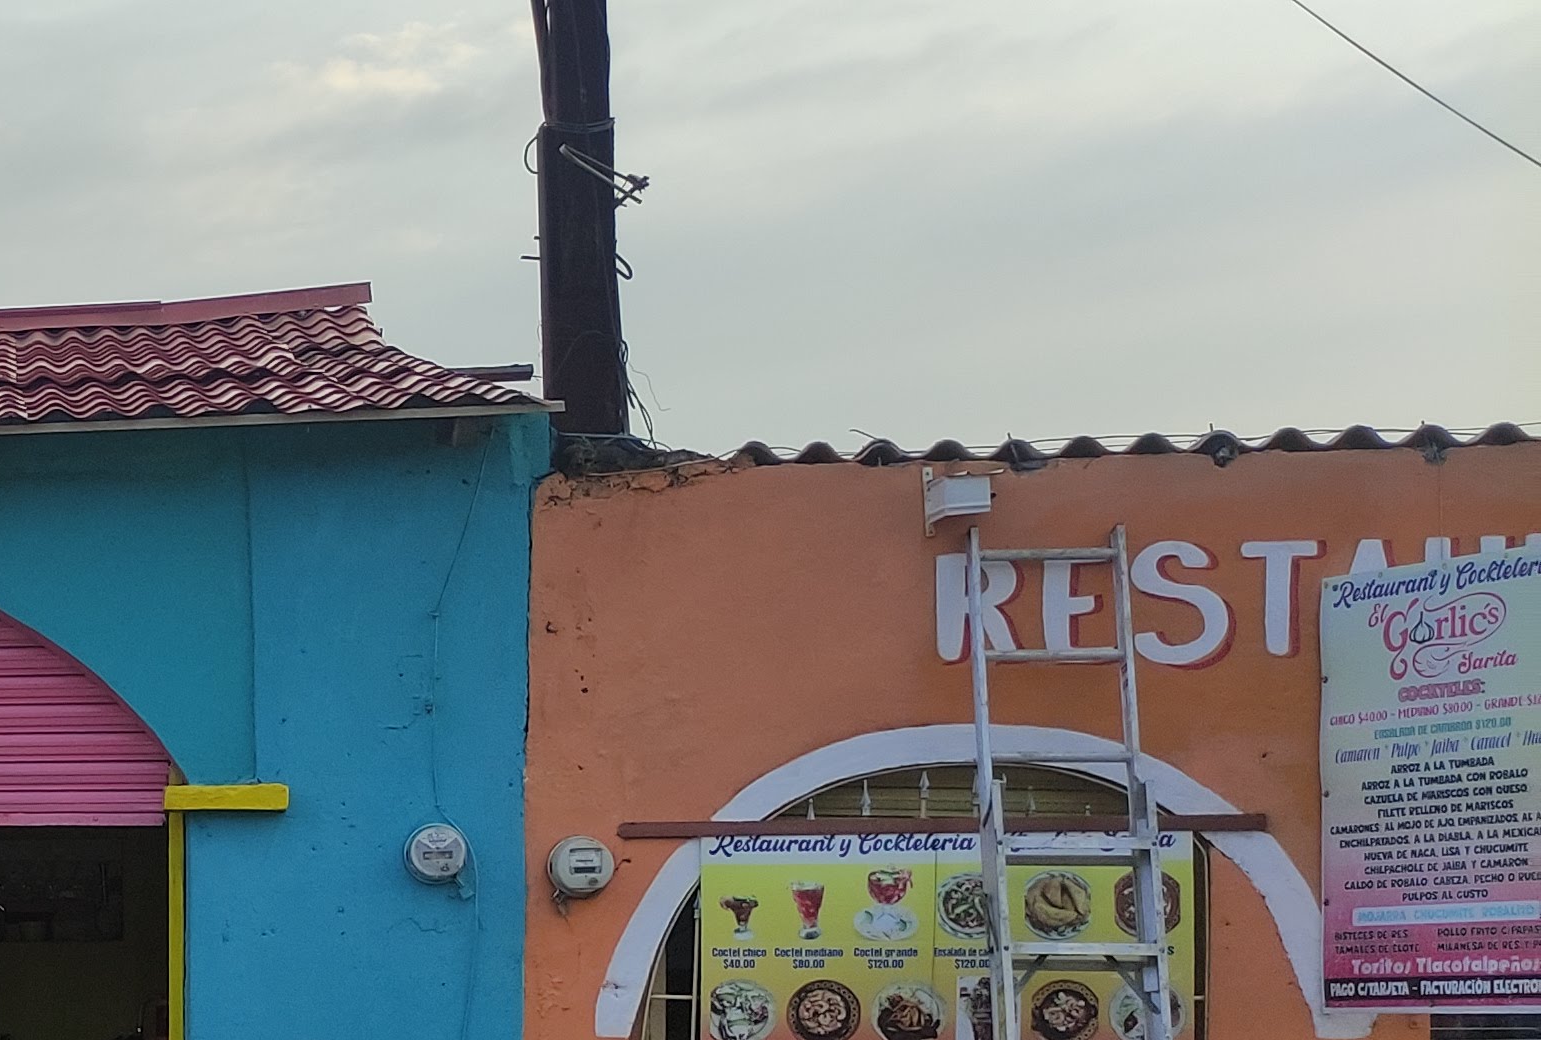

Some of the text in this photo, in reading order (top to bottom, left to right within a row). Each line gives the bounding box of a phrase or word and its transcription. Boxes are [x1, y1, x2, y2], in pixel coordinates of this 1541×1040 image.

[1439, 573, 1451, 596] y
[1457, 650, 1519, 675] Sarita
[1430, 738, 1460, 757] Jaiba
[1391, 756, 1495, 774] ARROZ LA TUMBADA
[1361, 768, 1528, 791] ARROZ LA TUMBADA CON ROBALO
[1364, 783, 1528, 805] CAZUELA DE MARISCOS CON QUESO
[1377, 799, 1514, 818] FILETE RELLENO DE MARISCOS
[1424, 819, 1434, 829] DE
[1424, 833, 1435, 843] LA
[1487, 828, 1498, 839] LA
[709, 834, 835, 858] Restaurant
[839, 839, 851, 858] y
[1396, 850, 1407, 860] DE
[1474, 842, 1529, 854] CHUCUMITE
[1364, 862, 1424, 875] CHILPACHOLE
[1427, 862, 1438, 872] DE
[1441, 860, 1467, 871] JAIBA
[1344, 880, 1374, 890] CALDO
[1377, 879, 1388, 889] DE
[1474, 873, 1504, 884] PECHO
[1402, 888, 1488, 902] PULPOS AL GUSTO
[1377, 930, 1388, 939] DE
[1391, 929, 1409, 939] RES
[1437, 927, 1467, 937] POLLO
[1470, 926, 1497, 936] FRITO
[712, 947, 740, 958] Coctel
[742, 947, 767, 958] chico
[774, 947, 803, 958] Coctel
[805, 947, 844, 958] mediano
[853, 947, 882, 958] Coctel
[884, 948, 918, 959] grande
[934, 947, 967, 958] Ensalada
[969, 947, 977, 958] de
[1378, 944, 1389, 953] DE
[1437, 941, 1484, 951] MILANESA
[1487, 941, 1498, 950] DE
[723, 959, 755, 969] $40.00
[792, 959, 825, 969] $80.00
[867, 959, 904, 969] $120.00
[1330, 982, 1355, 997] PAGO
[1357, 981, 1410, 996] C/TARJETA
